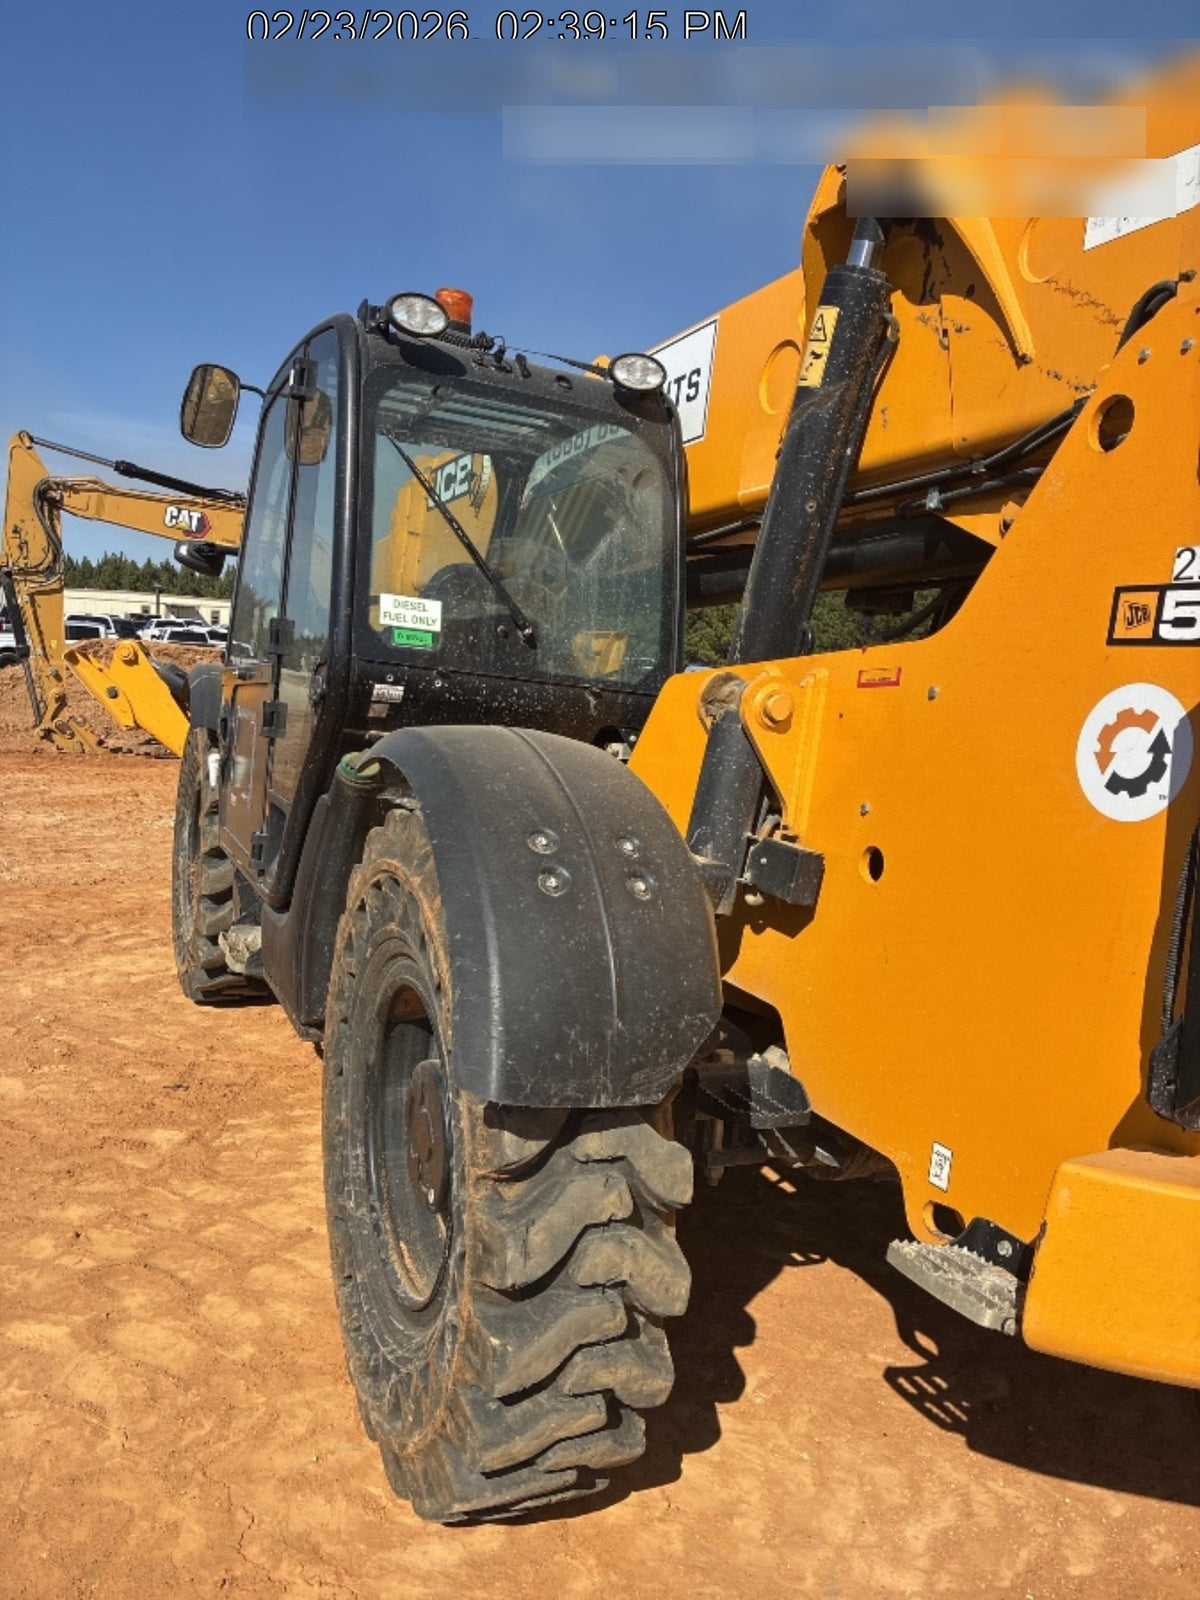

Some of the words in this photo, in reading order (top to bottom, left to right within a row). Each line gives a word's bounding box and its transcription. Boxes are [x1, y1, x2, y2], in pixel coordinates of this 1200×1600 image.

[164, 505, 202, 533] CAT
[393, 599, 428, 612] DIESEL
[1124, 601, 1151, 629] JCB
[383, 611, 408, 623] FUEL
[411, 614, 438, 627] ONLY
